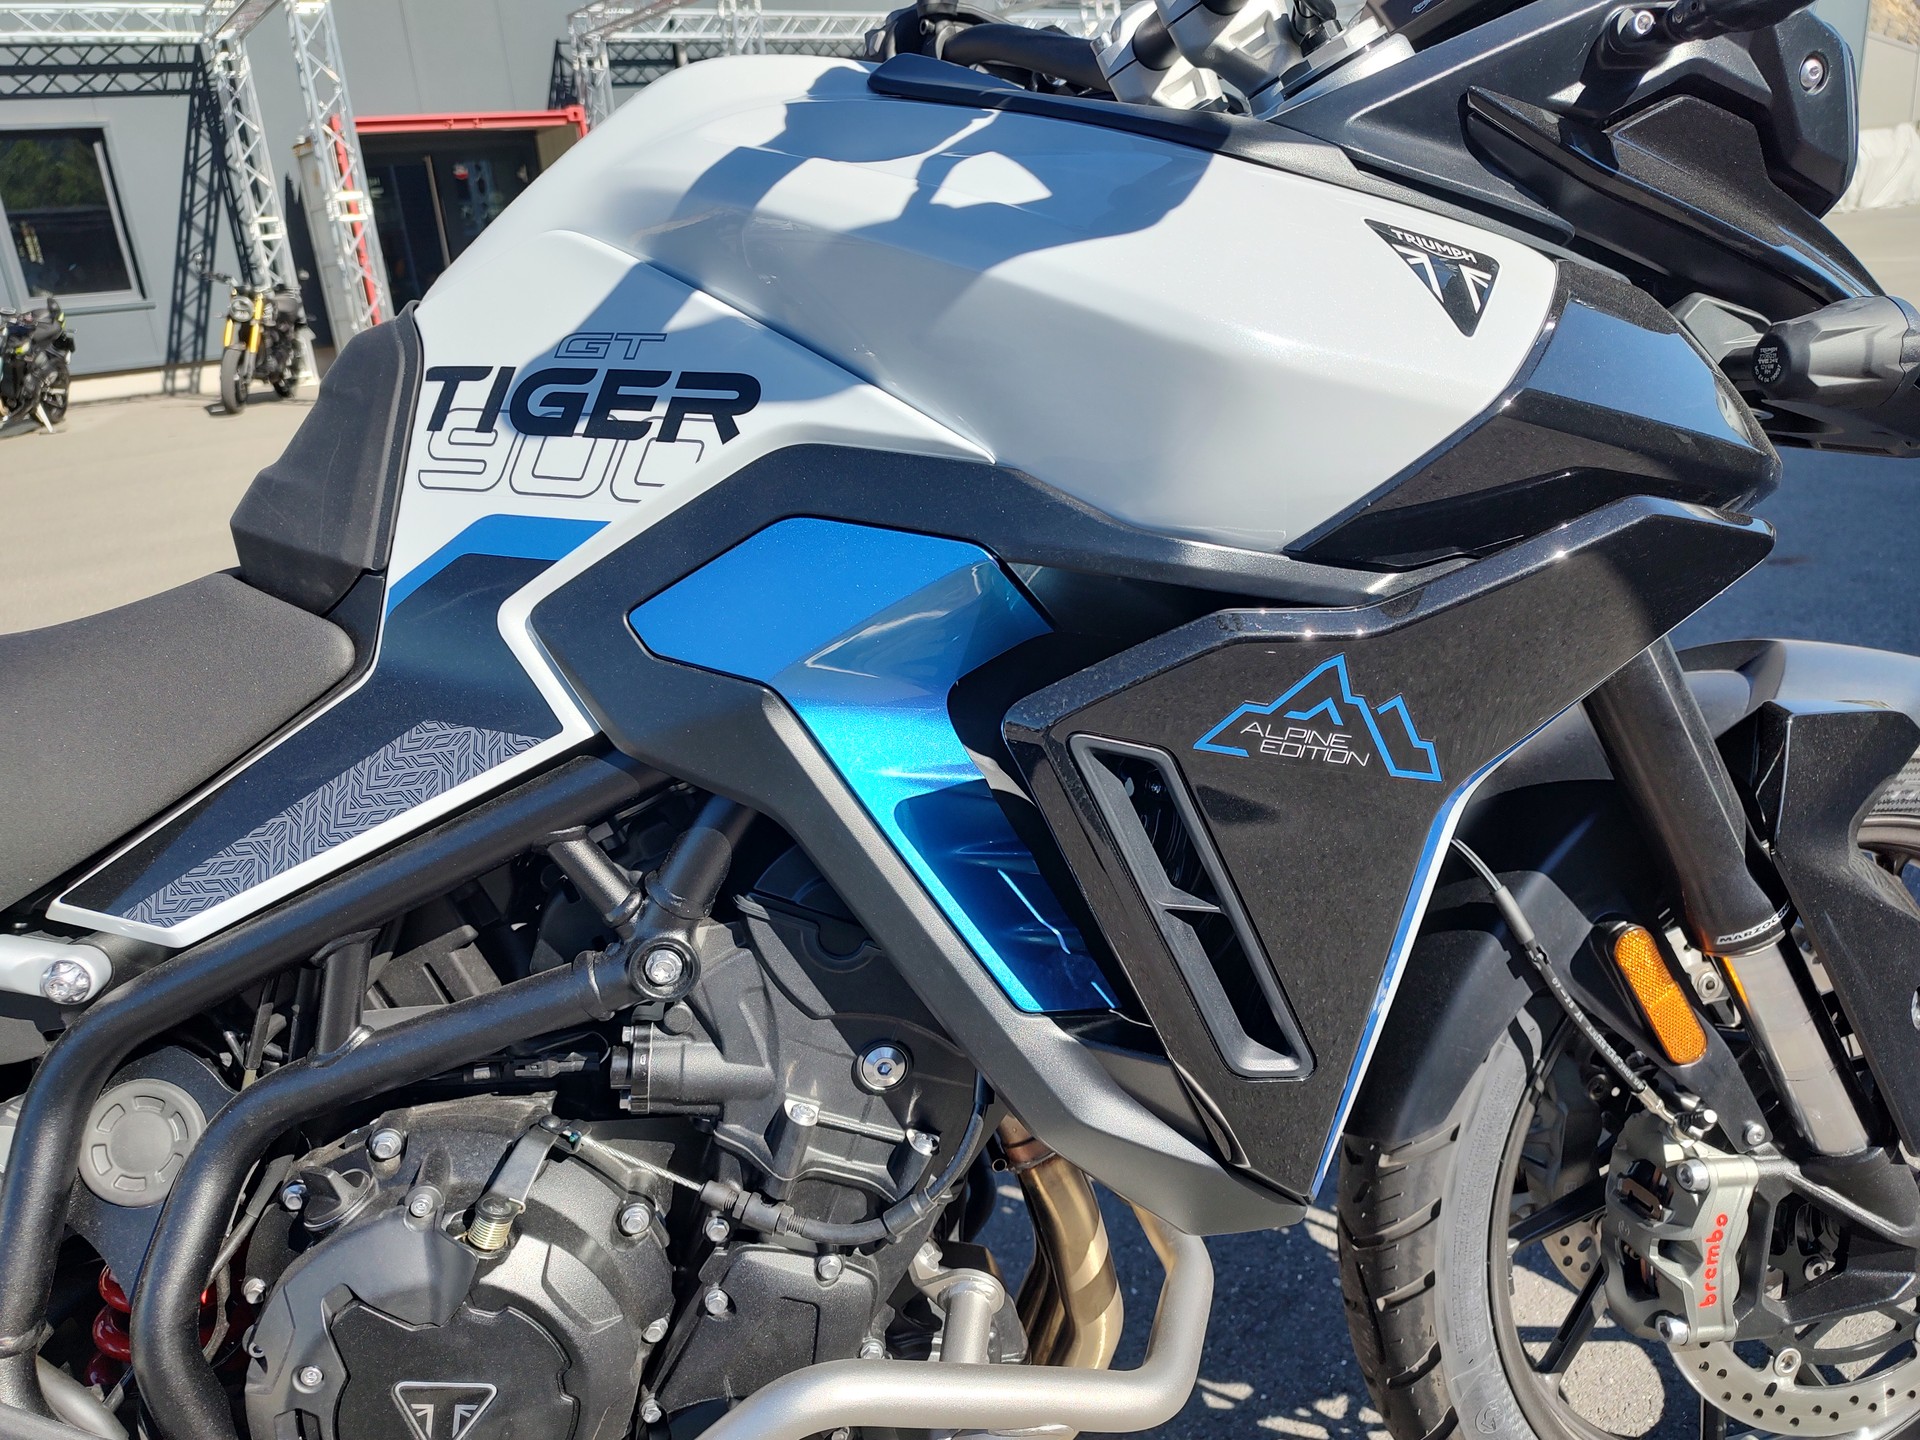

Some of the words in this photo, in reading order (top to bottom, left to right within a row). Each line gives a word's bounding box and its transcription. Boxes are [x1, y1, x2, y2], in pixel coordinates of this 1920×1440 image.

[1391, 230, 1477, 263] TRIUMPH
[554, 332, 667, 360] GT
[425, 366, 761, 444] TIGER
[1240, 721, 1352, 749] ALPINE
[1260, 739, 1370, 767] EDITION
[1720, 905, 1789, 942] MARZOCCH
[1698, 1213, 1728, 1308] brembo
